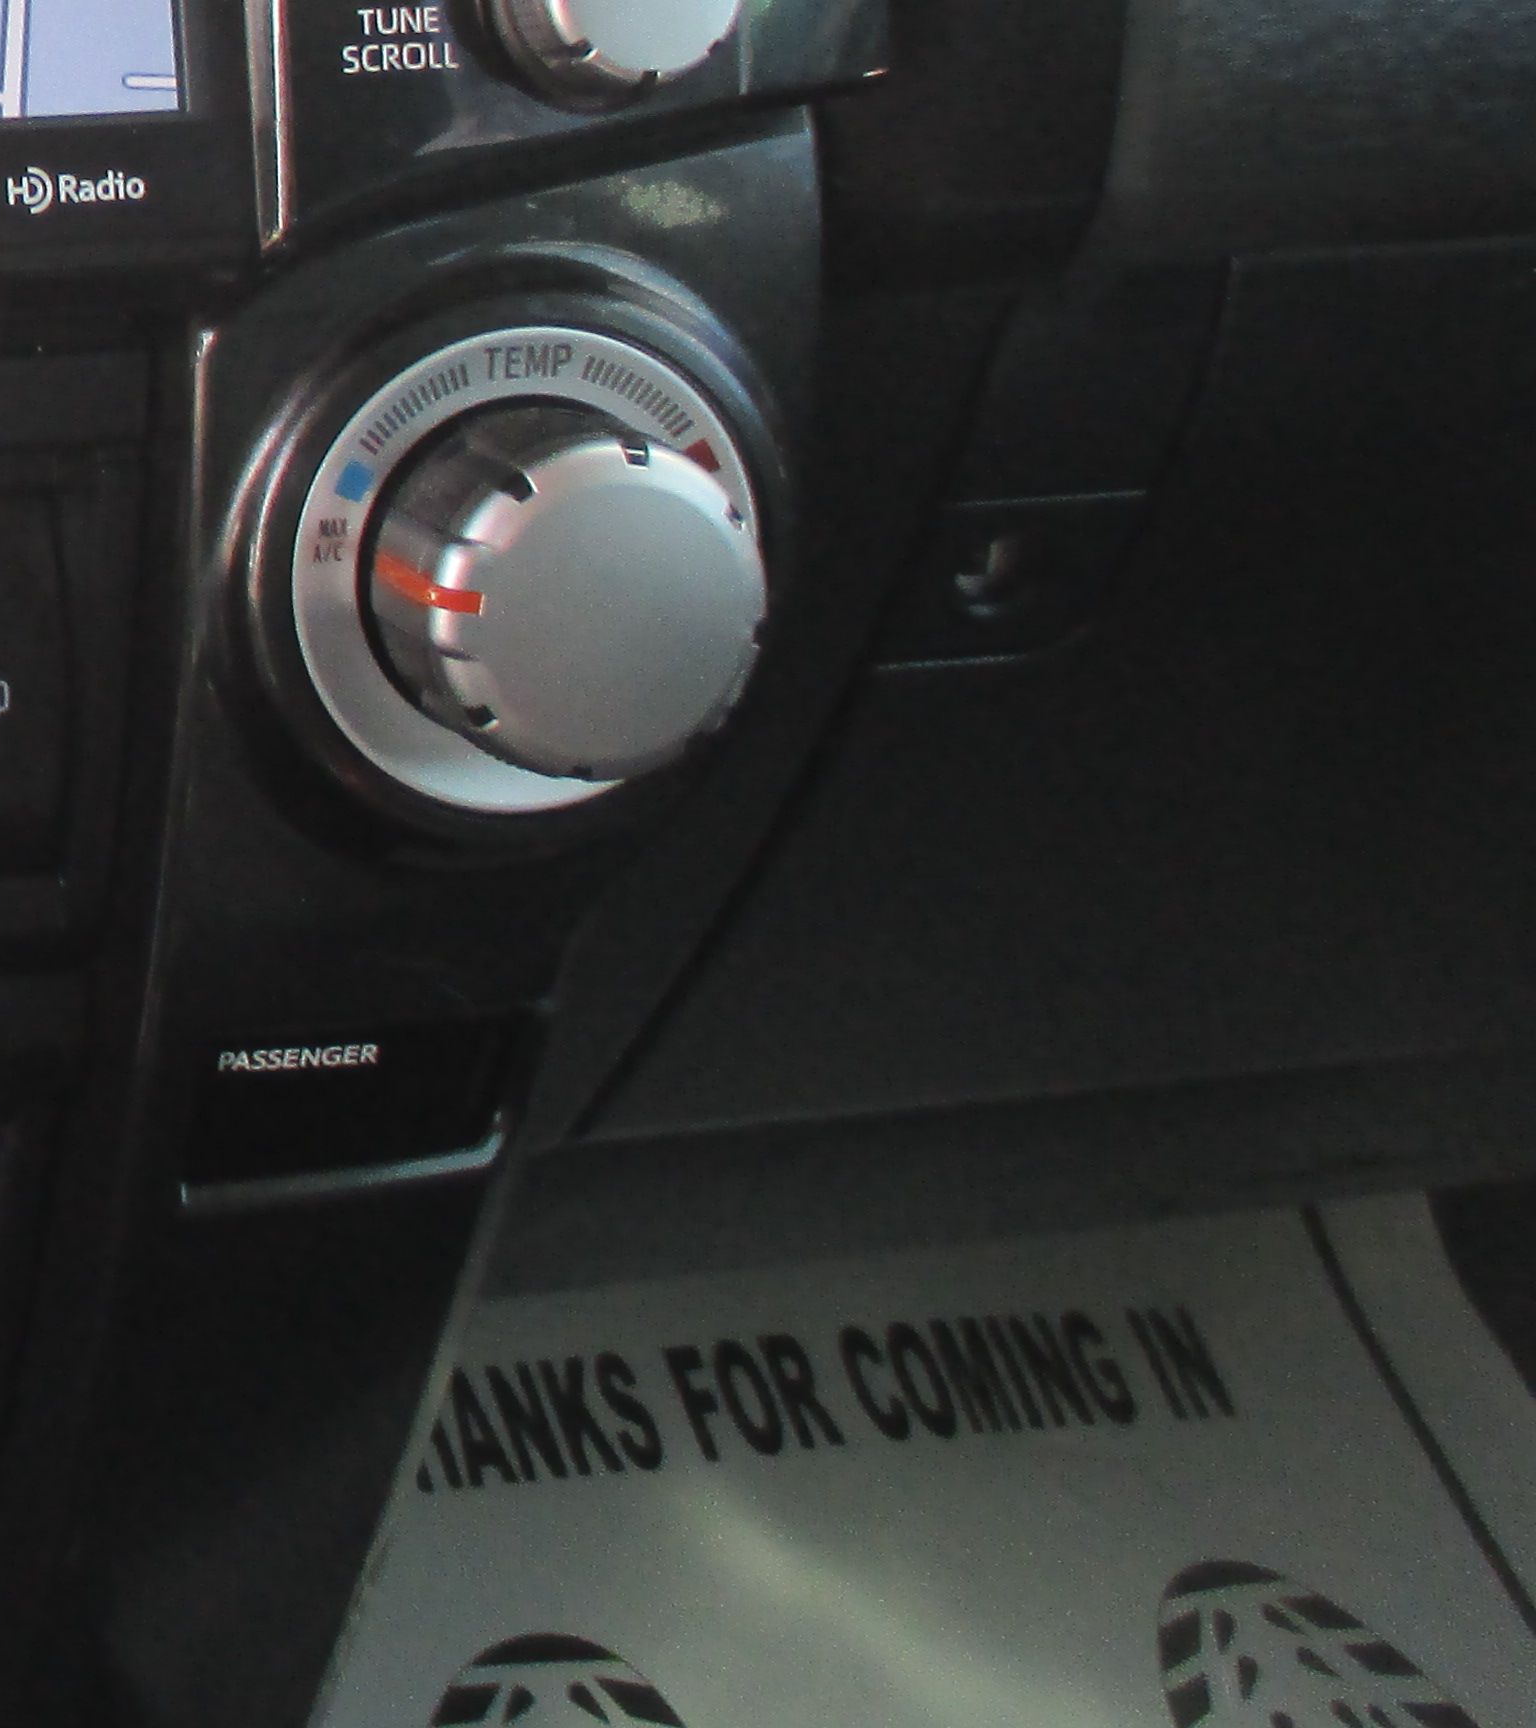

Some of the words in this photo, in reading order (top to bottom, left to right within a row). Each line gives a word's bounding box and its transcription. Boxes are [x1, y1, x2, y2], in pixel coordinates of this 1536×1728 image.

[357, 6, 440, 36] TUNE
[341, 43, 460, 75] SCROLL
[58, 169, 146, 204] Radio
[483, 343, 573, 382] TEMP
[217, 1043, 379, 1072] PASSENGER
[662, 1331, 848, 1462] FOR
[838, 1309, 1137, 1441] COMING
[1127, 1303, 1236, 1421] IN
